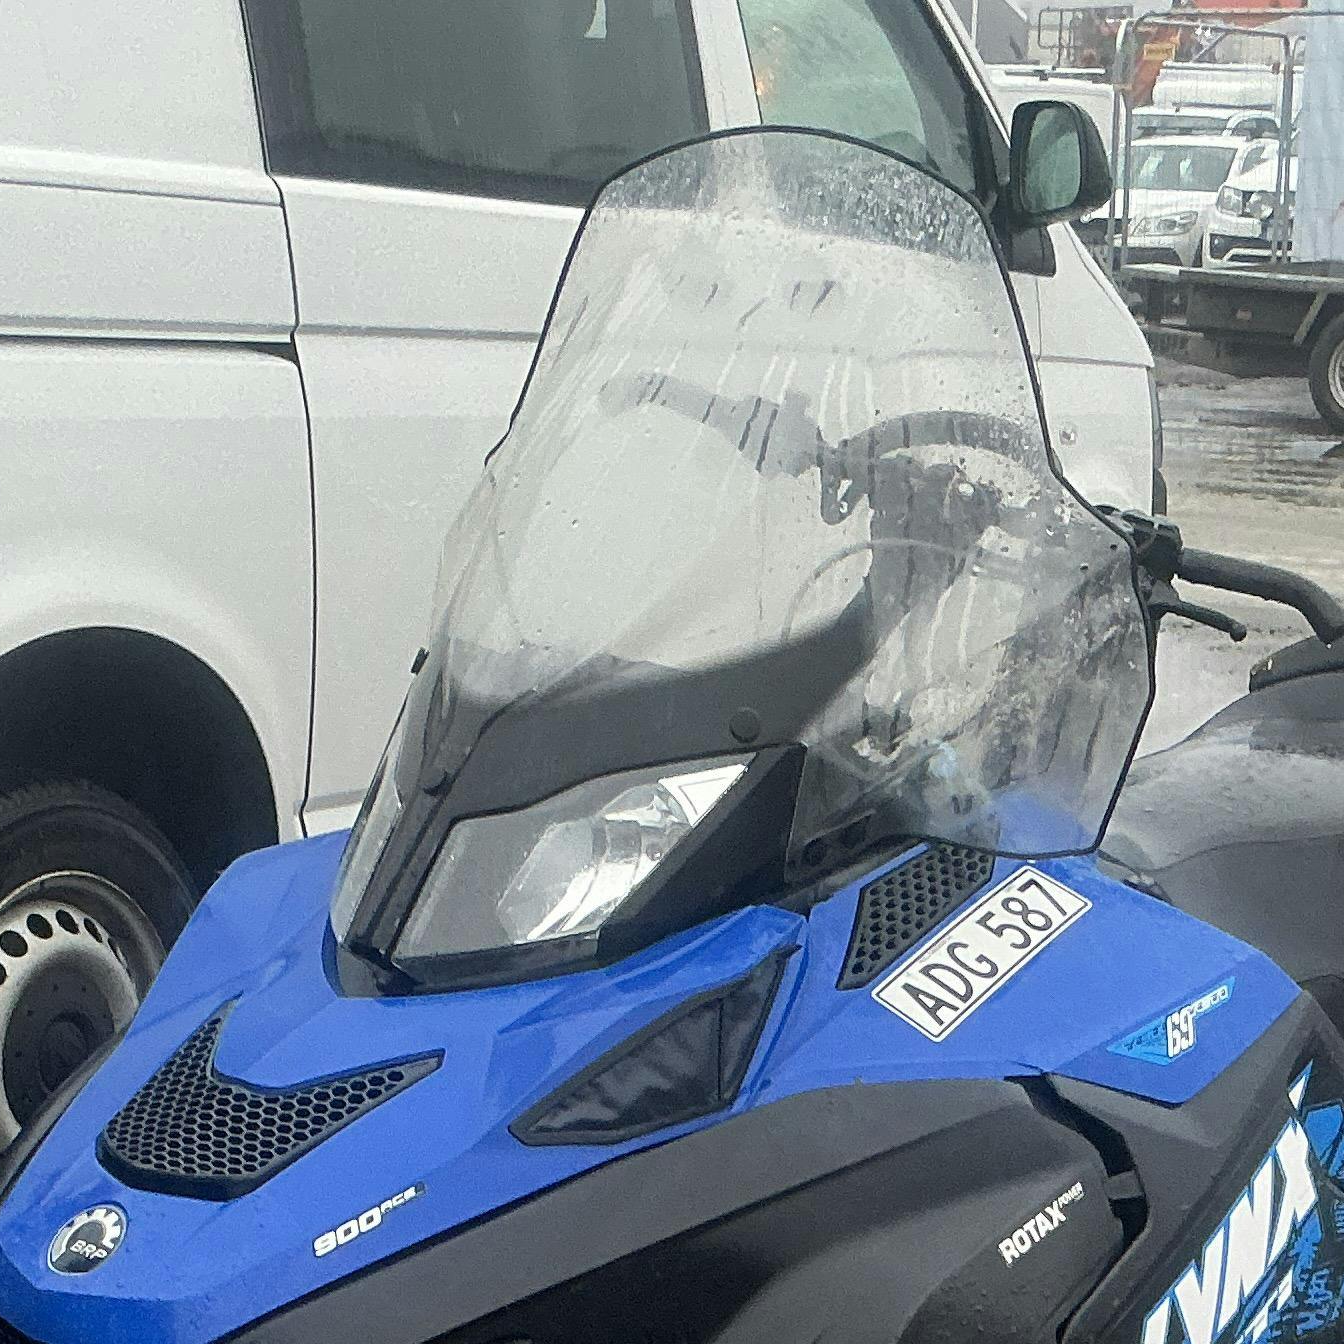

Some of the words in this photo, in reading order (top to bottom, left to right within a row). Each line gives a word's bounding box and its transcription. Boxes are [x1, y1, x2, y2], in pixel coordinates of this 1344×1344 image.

[900, 941, 1000, 1026] ADG
[974, 878, 1068, 950] 587
[1166, 1004, 1195, 1059] 69
[69, 1239, 108, 1260] BRP
[313, 1205, 382, 1257] 900
[998, 1200, 1067, 1265] ROTAX
